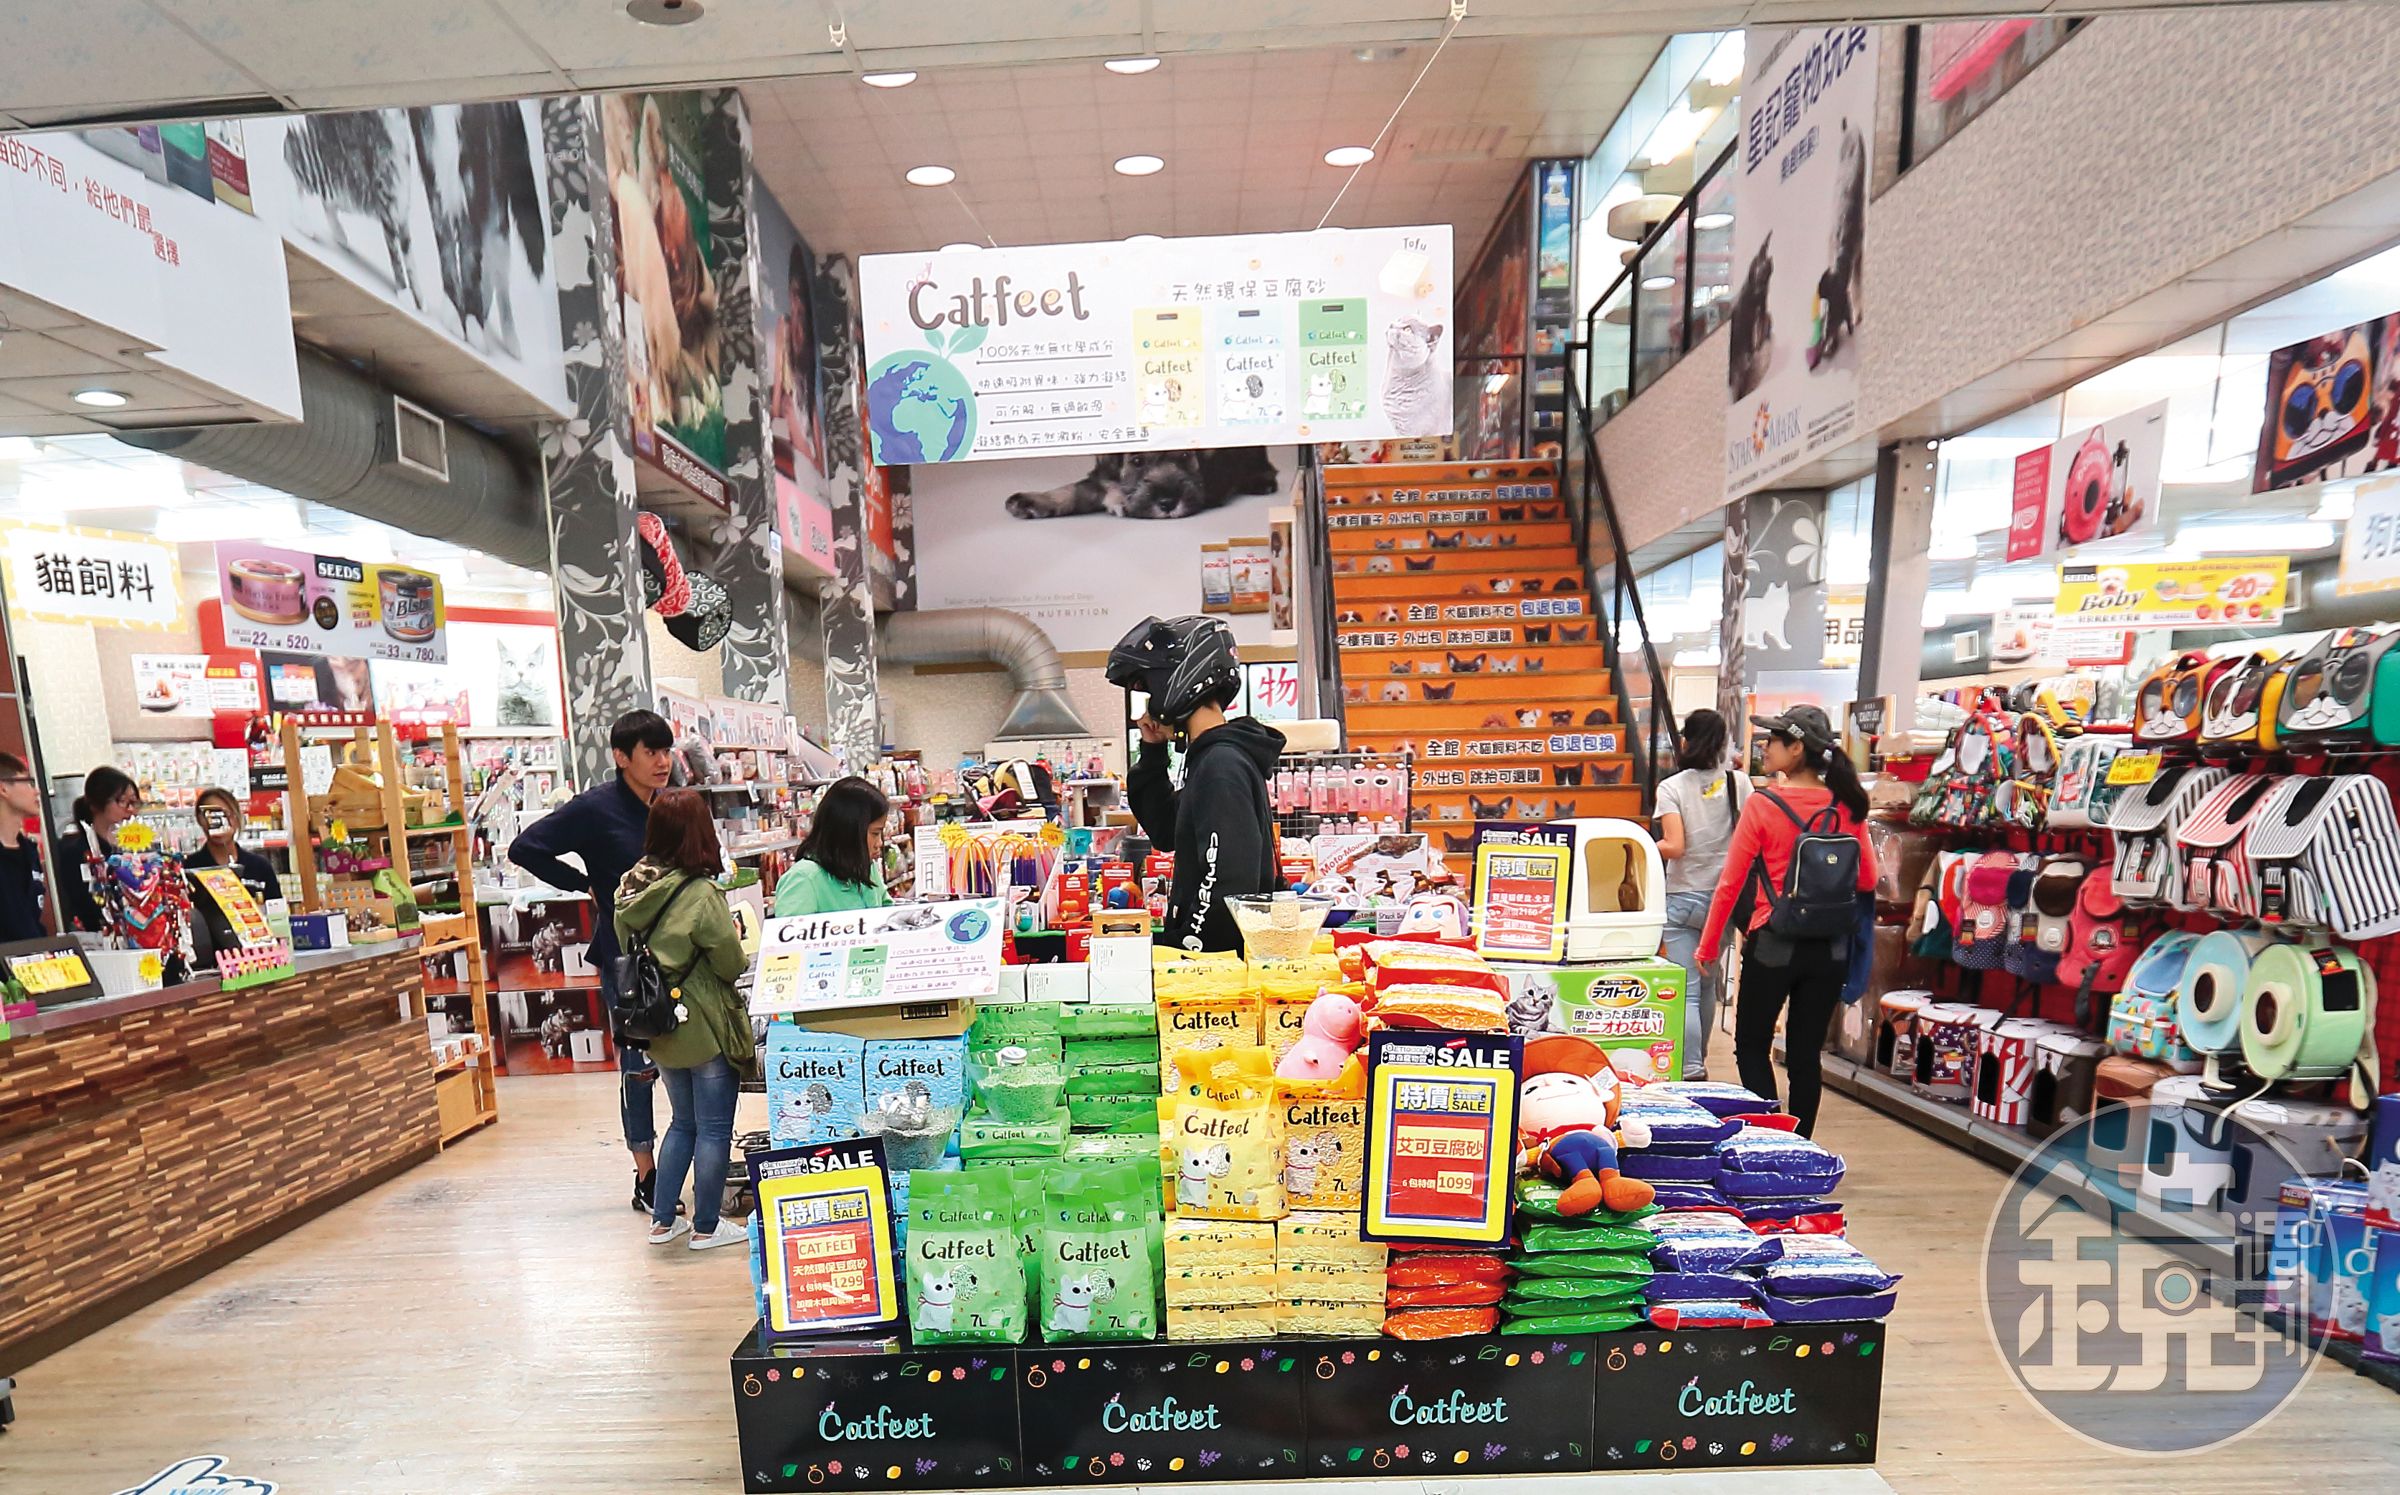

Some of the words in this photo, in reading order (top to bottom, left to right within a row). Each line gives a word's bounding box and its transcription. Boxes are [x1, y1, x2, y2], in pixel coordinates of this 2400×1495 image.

[1172, 278, 1327, 301] 天然環保豆腐砂
[908, 270, 1090, 330] Catfeet
[1145, 360, 1193, 375] Catfeet
[1226, 356, 1274, 372] Catfeet
[1309, 352, 1358, 367] Catfeet
[1393, 490, 1421, 502] 全館
[34, 553, 155, 603] 貓飼料
[318, 562, 362, 581] SEEDS
[2228, 579, 2256, 598] 20
[1037, 608, 1110, 618] NUTRITION
[1409, 605, 1439, 620] 全館
[1445, 605, 1516, 617] 犬貓飼料不吃
[1521, 600, 1581, 615] 包退包換
[252, 631, 268, 646] 22
[286, 634, 309, 650] 520
[1404, 630, 1441, 644] 外出包
[387, 645, 400, 659] 33
[416, 647, 434, 662] 780
[1428, 741, 1459, 756] 全館
[1466, 741, 1543, 754] 犬貓飼料不吃
[1550, 735, 1616, 752] 包退包換
[1423, 771, 1464, 785] 外出包
[1518, 832, 1569, 847] SALE
[1492, 859, 1528, 877] 特價
[779, 917, 867, 943] Catfeet
[1592, 986, 1647, 999] デオトイレ
[1172, 1010, 1240, 1030] Catfeet
[1574, 1009, 1663, 1021] 閉めきったお部屋でも
[879, 1058, 946, 1078] Catfeet
[1436, 1048, 1511, 1069] SALE
[779, 1060, 847, 1080] Catfeet
[1400, 1085, 1451, 1111] 特價
[1452, 1101, 1486, 1112] SALE
[1287, 1106, 1361, 1127] Catfeet
[826, 1125, 840, 1138] 7L
[1184, 1115, 1250, 1138] Catfeet
[1397, 1137, 1484, 1157] 艾可豆腐砂
[809, 1150, 876, 1174] SALE
[1332, 1178, 1349, 1192] 7L
[1438, 1176, 1473, 1190] 1099
[1224, 1191, 1241, 1206] 7L
[786, 1200, 832, 1226] 特價
[833, 1208, 864, 1219] SALE
[939, 1210, 979, 1223] Catfeet
[799, 1243, 821, 1256] CAT
[826, 1239, 855, 1252] FEET
[921, 1238, 996, 1262] Catfeet
[1059, 1239, 1131, 1262] Catfeet
[792, 1259, 868, 1277] 天然環保豆腐砂
[832, 1275, 863, 1289] 1299
[970, 1314, 987, 1328] 7L
[1108, 1316, 1125, 1328] 7L
[1389, 1388, 1508, 1426] Catfeet
[1678, 1380, 1797, 1418] Catfeet
[819, 1405, 936, 1441] Catfeet
[1103, 1396, 1222, 1434] Catfeet
